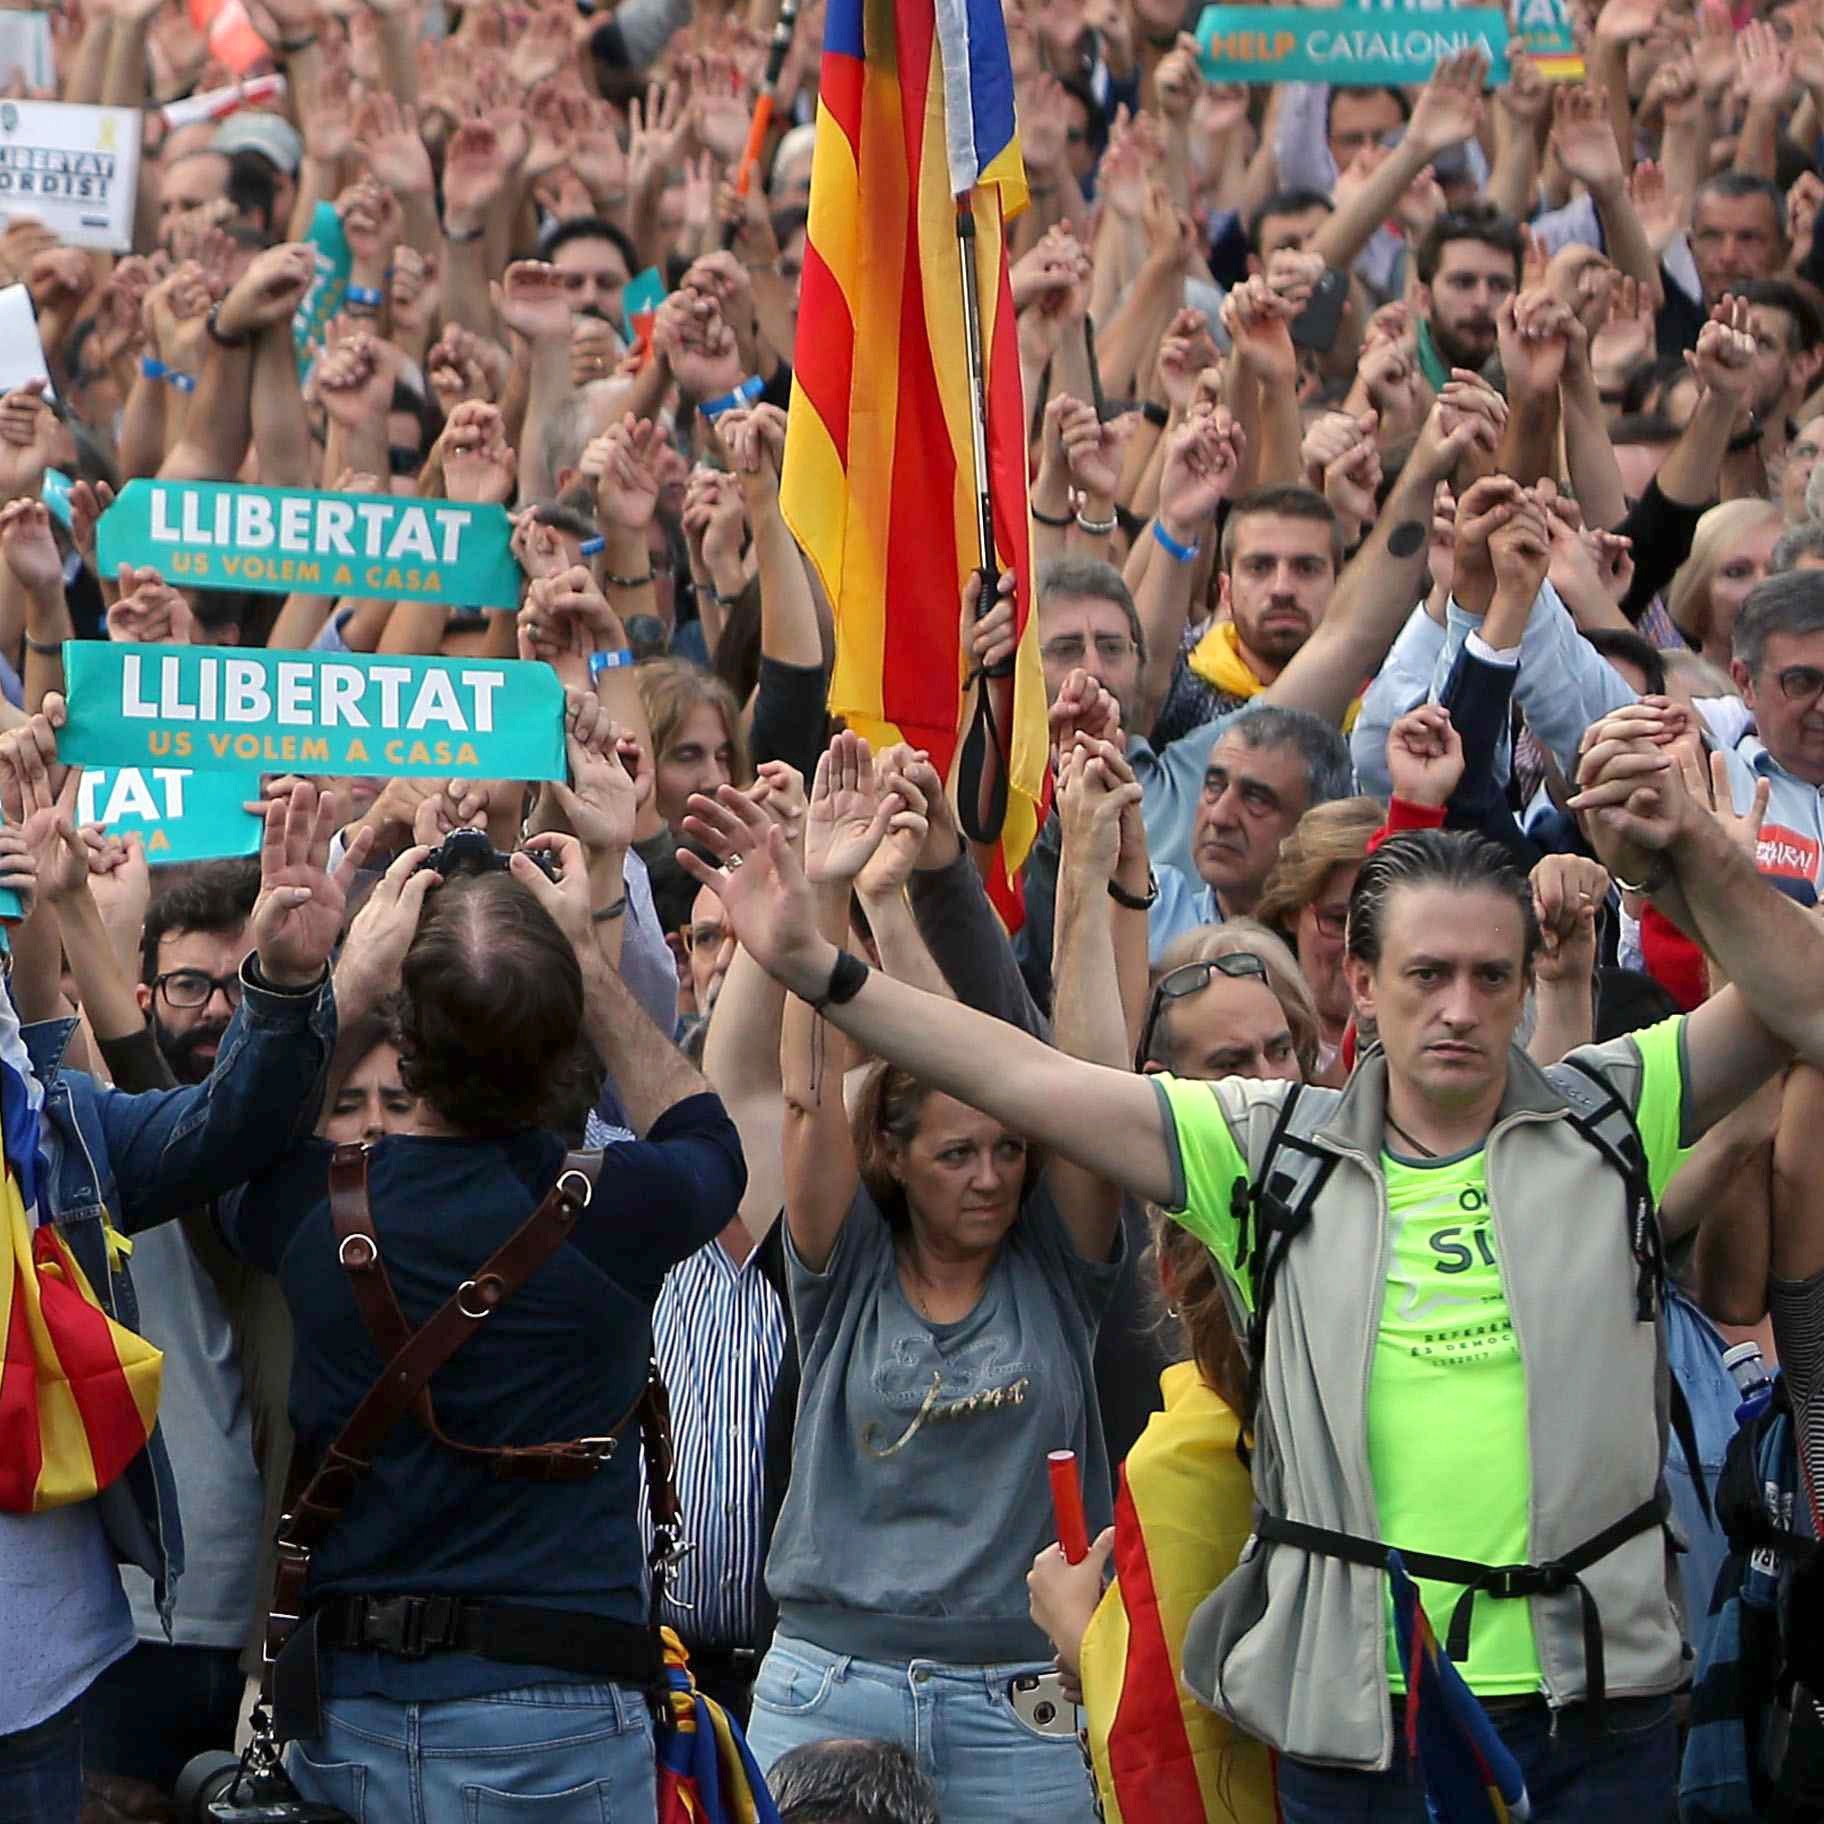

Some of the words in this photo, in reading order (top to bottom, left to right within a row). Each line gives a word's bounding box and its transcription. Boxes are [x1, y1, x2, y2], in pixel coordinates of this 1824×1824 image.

[1210, 30, 1297, 62] HELP
[1304, 27, 1495, 63] CATALONIA
[150, 488, 472, 562] LLIBERTAT
[171, 552, 209, 573] US
[223, 555, 321, 583] VOLEM
[334, 564, 353, 584] A
[365, 566, 443, 593] CASA
[122, 654, 505, 732] LLIBERTAT
[150, 731, 192, 757] US
[207, 732, 328, 762] VOLEM
[345, 738, 368, 763] A
[384, 739, 479, 766] CASA
